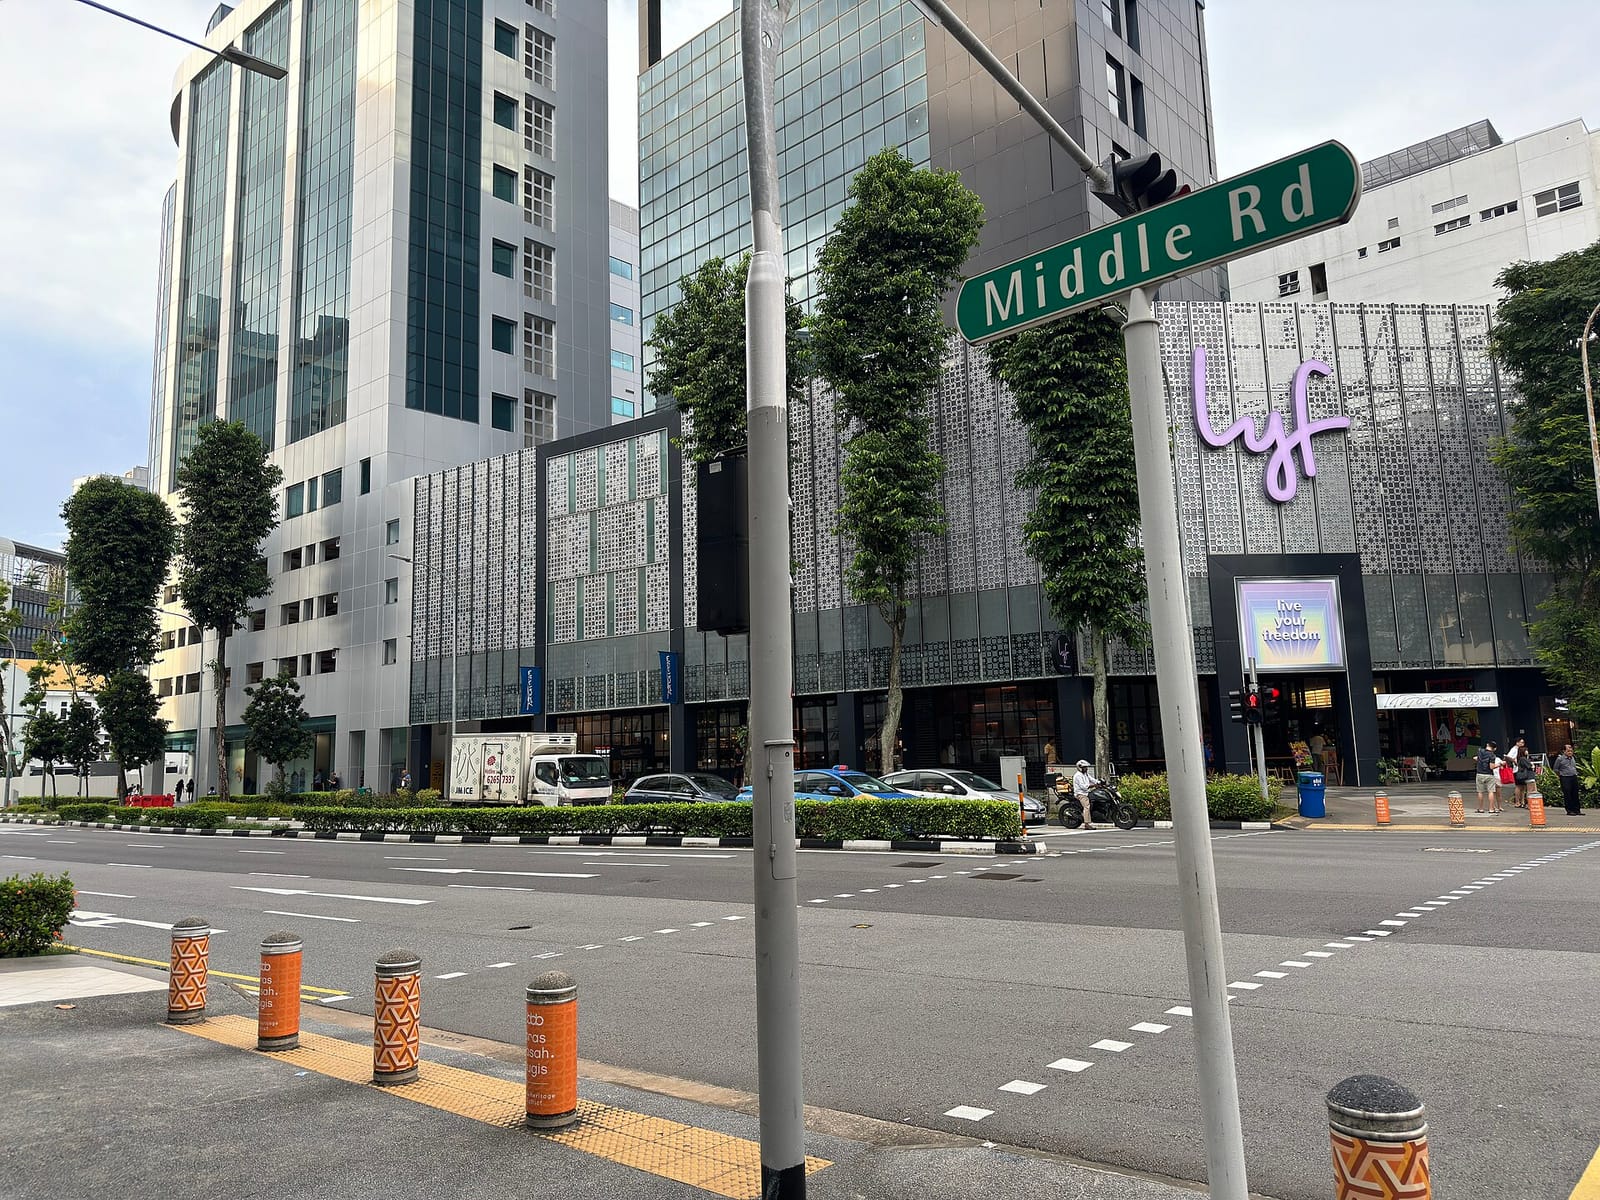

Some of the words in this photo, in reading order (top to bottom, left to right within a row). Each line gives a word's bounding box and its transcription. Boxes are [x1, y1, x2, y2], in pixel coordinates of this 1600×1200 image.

[984, 222, 1193, 326] Middle
[1228, 163, 1315, 242] Rd
[1193, 346, 1351, 502] lyf
[1277, 599, 1303, 612] live
[1274, 616, 1307, 630] your
[1262, 628, 1321, 641] freedom
[486, 775, 500, 784] 6265
[502, 775, 515, 784] 7337
[463, 786, 474, 795] ICE
[527, 1033, 547, 1044] ras
